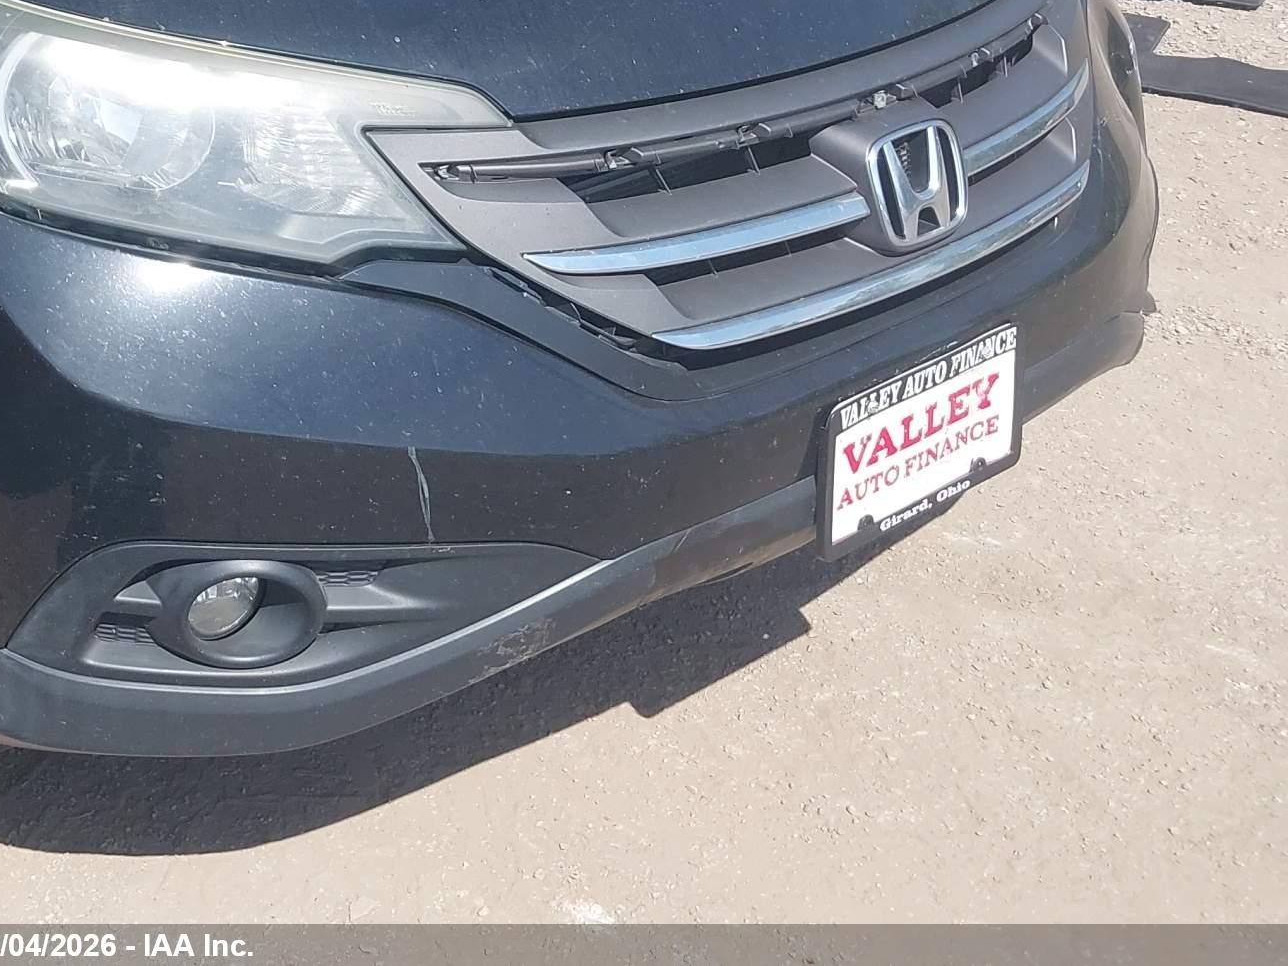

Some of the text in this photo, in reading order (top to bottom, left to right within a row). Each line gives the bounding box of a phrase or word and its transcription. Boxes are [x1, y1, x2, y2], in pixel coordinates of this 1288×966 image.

[902, 360, 947, 400] AUTO
[949, 326, 1017, 378] FINANCE
[837, 416, 1000, 511] AUTO FINANCE
[843, 372, 1000, 475] VALLEY
[880, 480, 971, 532] Girard, Ohio
